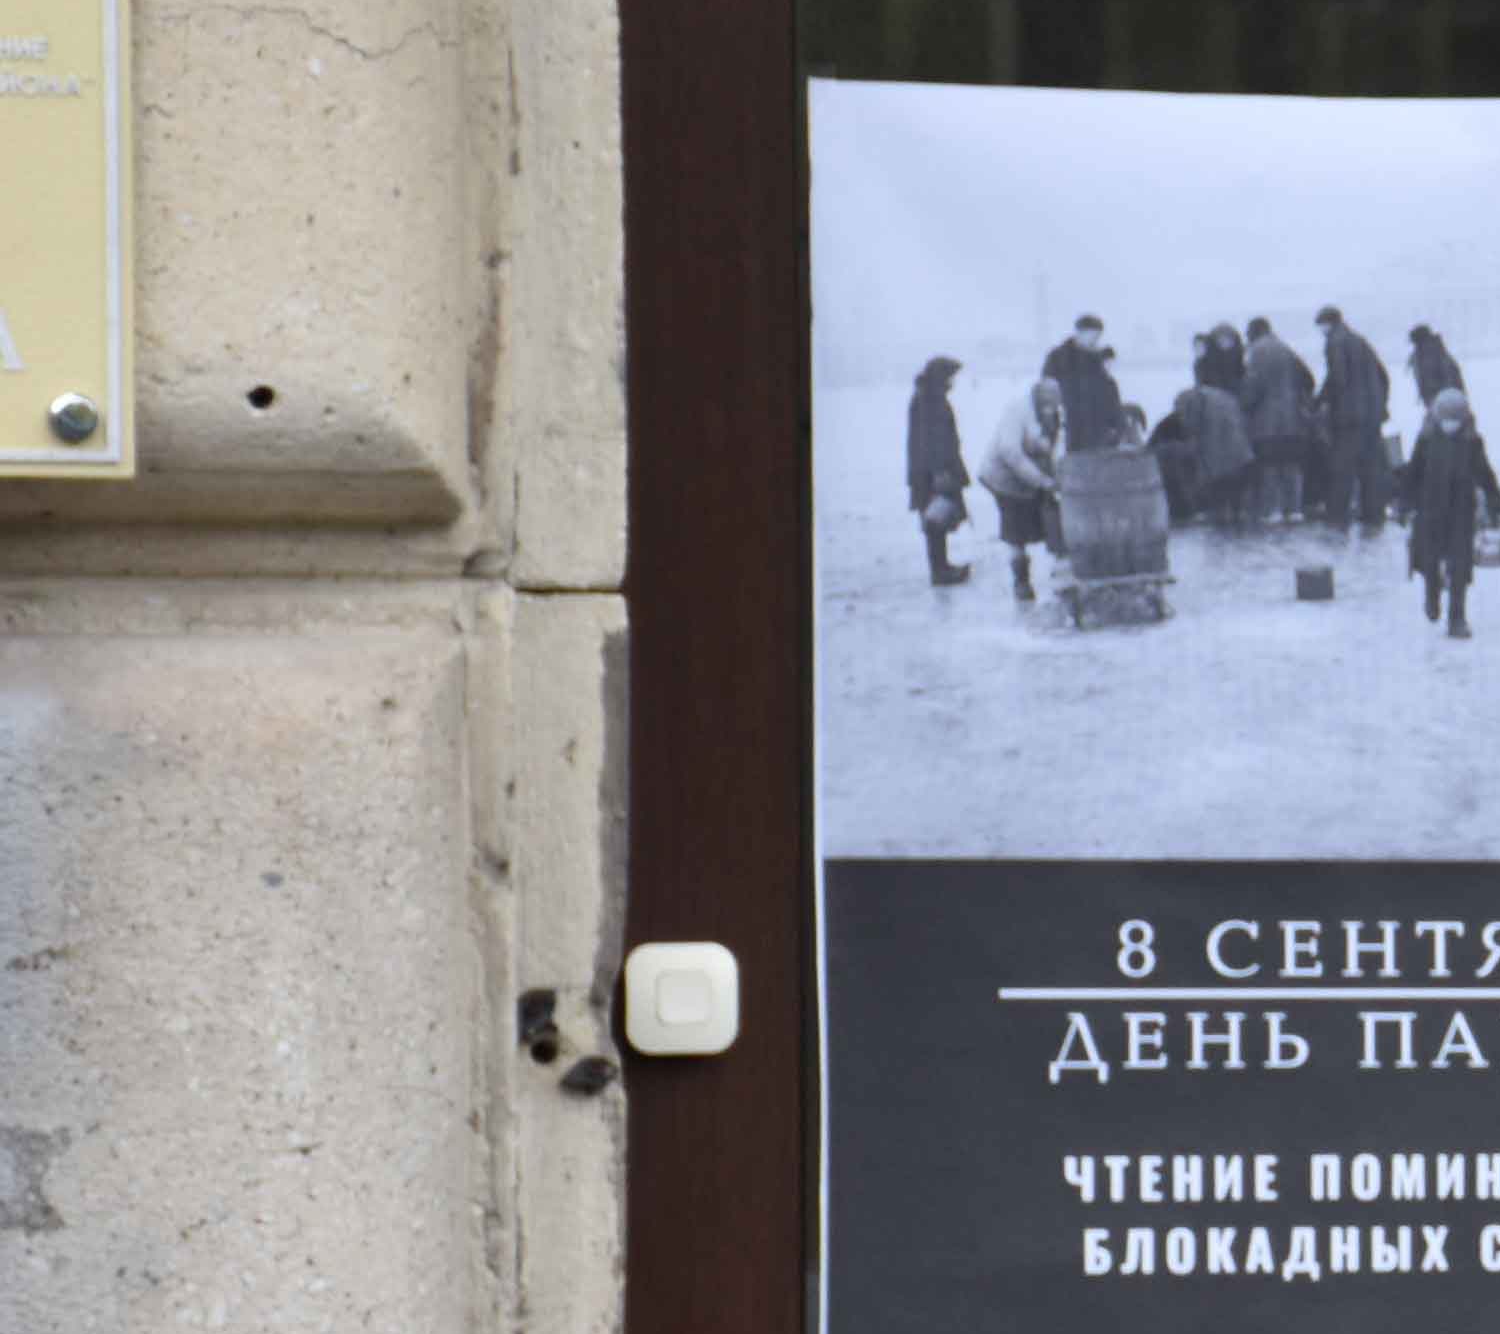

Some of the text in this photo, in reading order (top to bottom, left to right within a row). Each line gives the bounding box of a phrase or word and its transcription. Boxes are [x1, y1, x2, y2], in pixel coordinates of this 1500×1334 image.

[1117, 919, 1156, 978] 8
[1049, 1012, 1310, 1084] ДЕНЬ
[1064, 1154, 1278, 1203] ЧТЕНИЕ
[1083, 1225, 1449, 1282] БЛОКАДНЫХ
